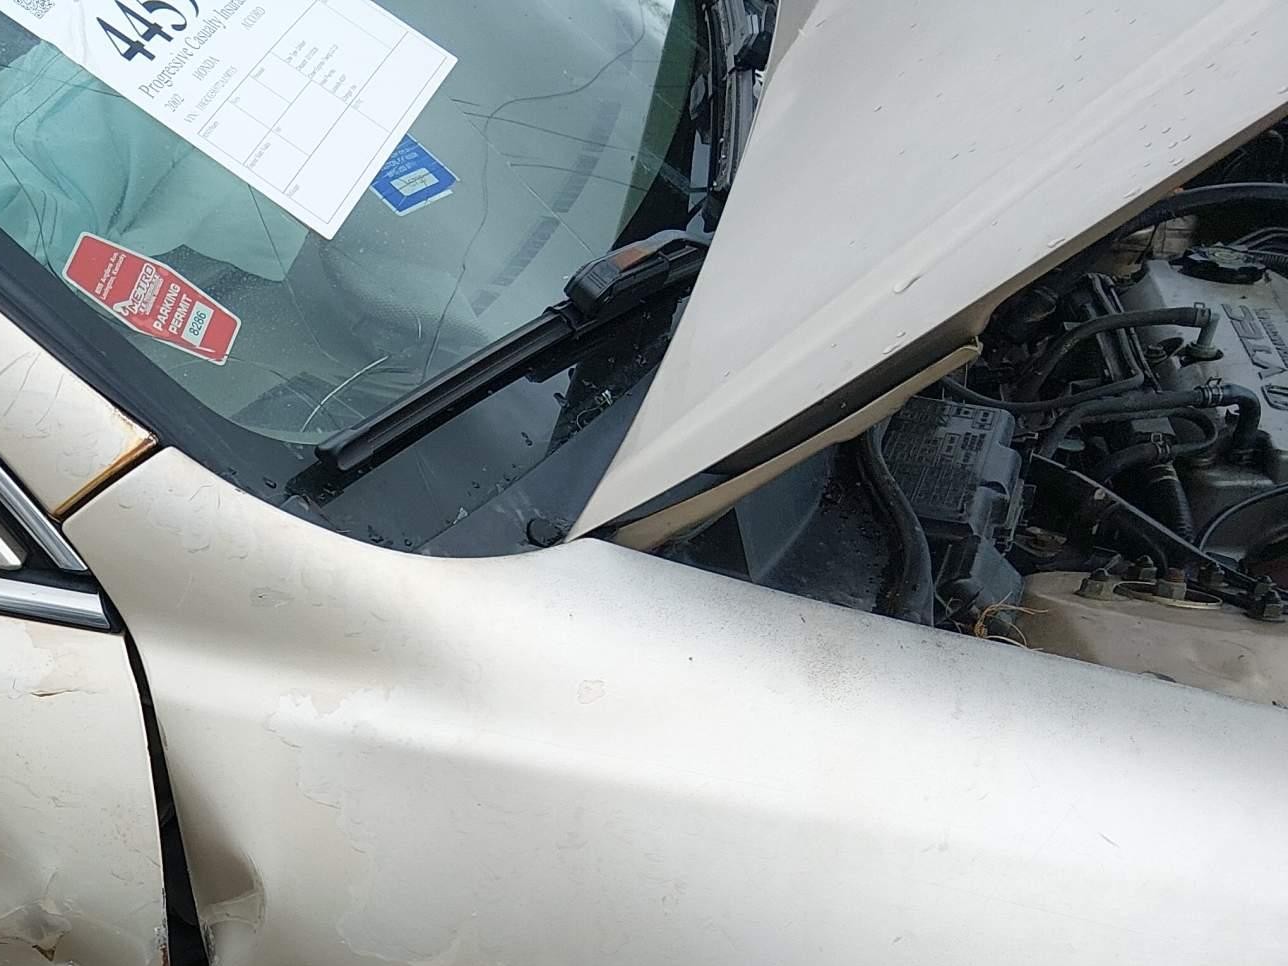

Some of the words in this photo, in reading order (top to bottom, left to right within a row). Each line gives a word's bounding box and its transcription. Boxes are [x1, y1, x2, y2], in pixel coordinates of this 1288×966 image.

[96, 0, 200, 61] 445
[138, 47, 193, 99] Progressive
[184, 15, 226, 50] Casualty
[164, 93, 184, 112] 2002
[192, 56, 220, 80] HONDA
[241, 6, 265, 30] ACCORD
[127, 263, 155, 315] METRO
[152, 283, 181, 331] PARKING
[168, 293, 193, 335] PERMIT
[188, 310, 207, 337] 8286
